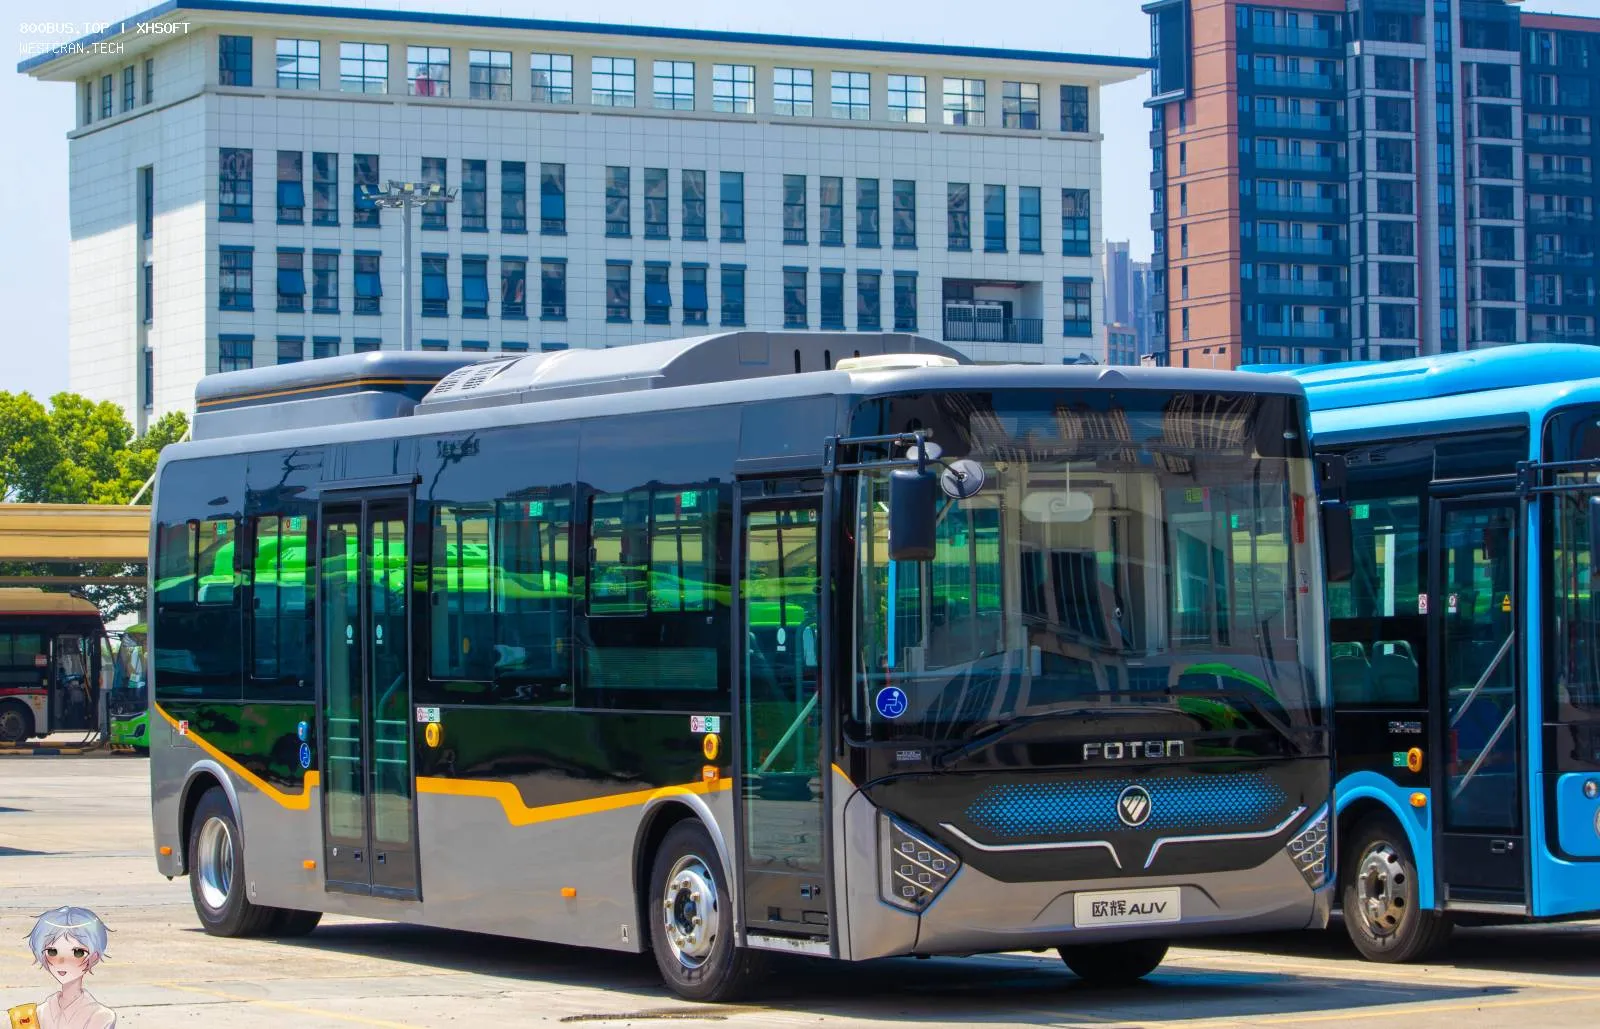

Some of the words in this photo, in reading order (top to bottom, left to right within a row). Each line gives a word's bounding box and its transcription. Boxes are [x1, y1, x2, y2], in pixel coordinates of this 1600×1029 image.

[1083, 740, 1184, 761] FOTON
[1092, 900, 1127, 917] 欧辉
[1128, 901, 1168, 915] AUV
